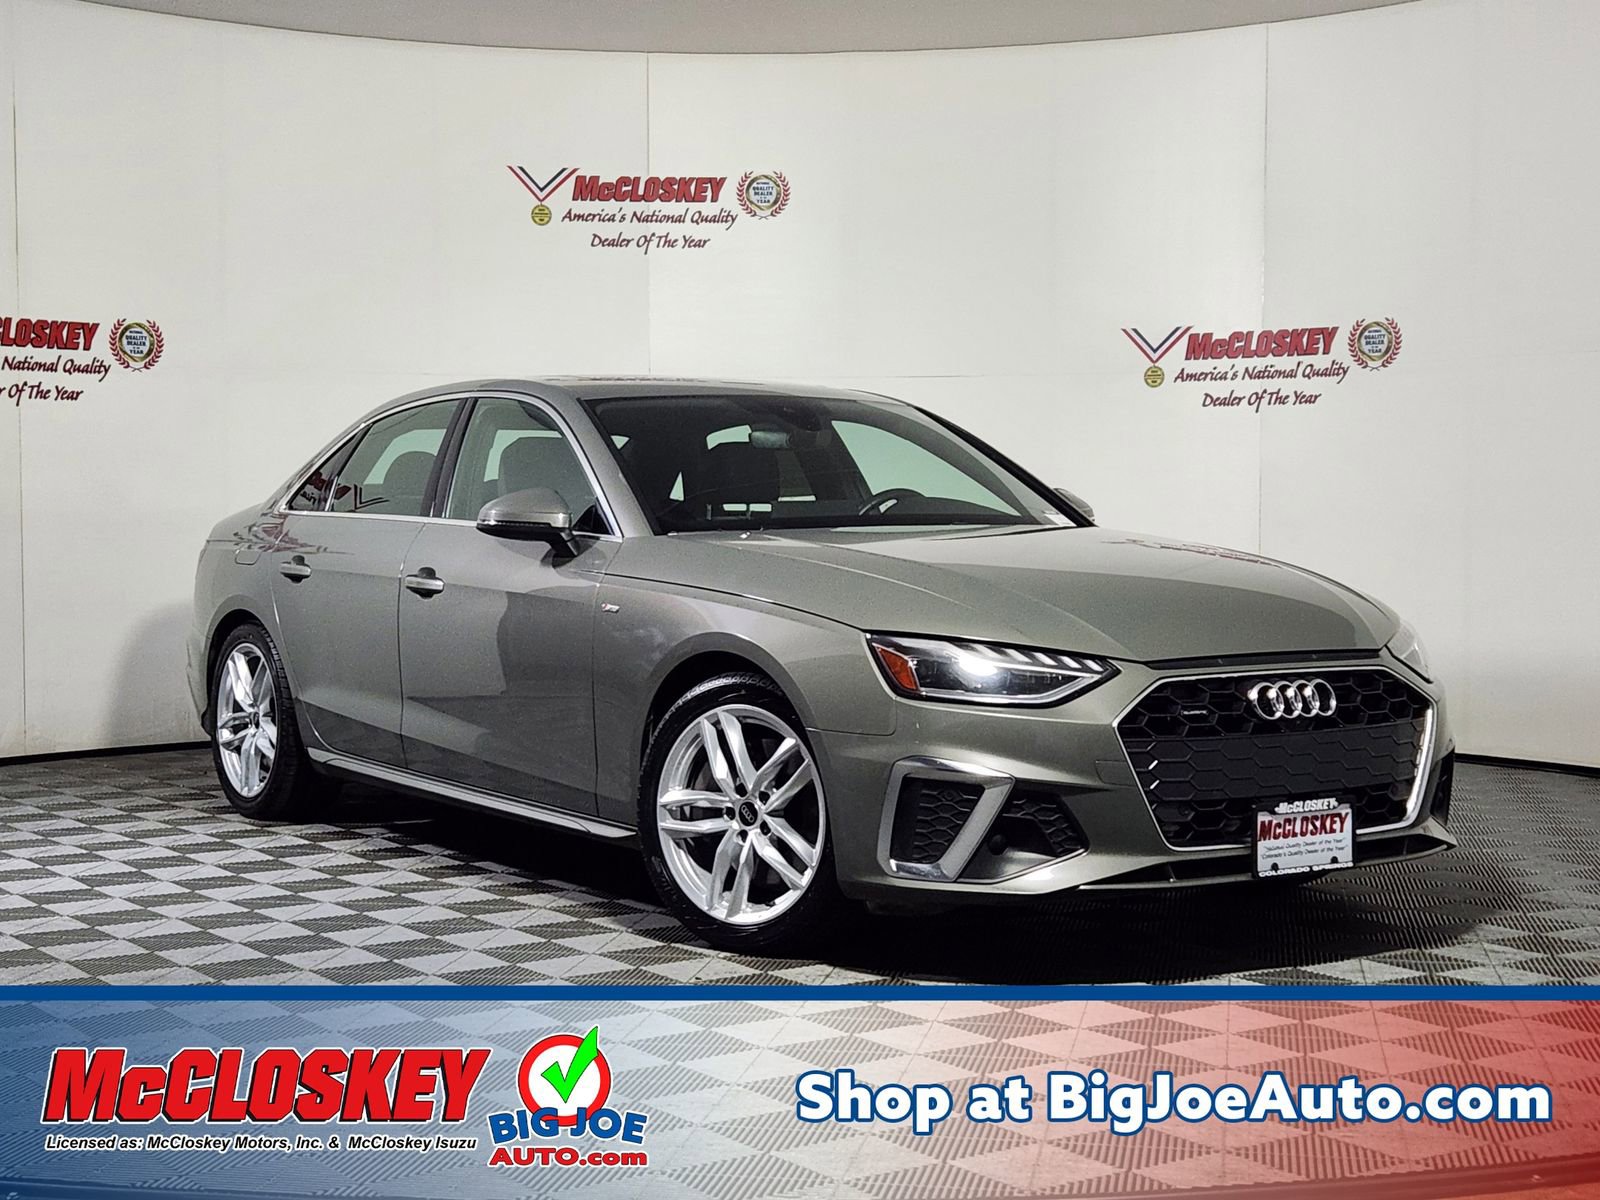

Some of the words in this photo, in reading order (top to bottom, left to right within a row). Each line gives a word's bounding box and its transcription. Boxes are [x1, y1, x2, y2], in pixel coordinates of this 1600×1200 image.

[572, 175, 727, 203] McCLOSKEY
[561, 207, 627, 224] America's
[630, 207, 687, 225] National
[691, 207, 738, 230] Quality
[590, 232, 634, 248] Dealer
[636, 232, 656, 255] Of
[656, 232, 679, 248] The
[682, 234, 711, 249] Year
[0, 316, 100, 351] LOSKEY
[1184, 326, 1340, 361] McCLOSKEY
[1, 355, 62, 373] National
[63, 357, 111, 382] Quality
[1173, 363, 1239, 384] America's
[1243, 361, 1302, 381] National
[1302, 360, 1349, 384] Quality
[8, 381, 28, 407] Of
[28, 381, 51, 400] The
[54, 385, 84, 401] Year
[1202, 389, 1245, 407] Dealer
[1248, 388, 1268, 413] Of
[1267, 388, 1291, 405] The
[1293, 391, 1322, 405] Year
[1258, 812, 1349, 842] McCLOSKEY
